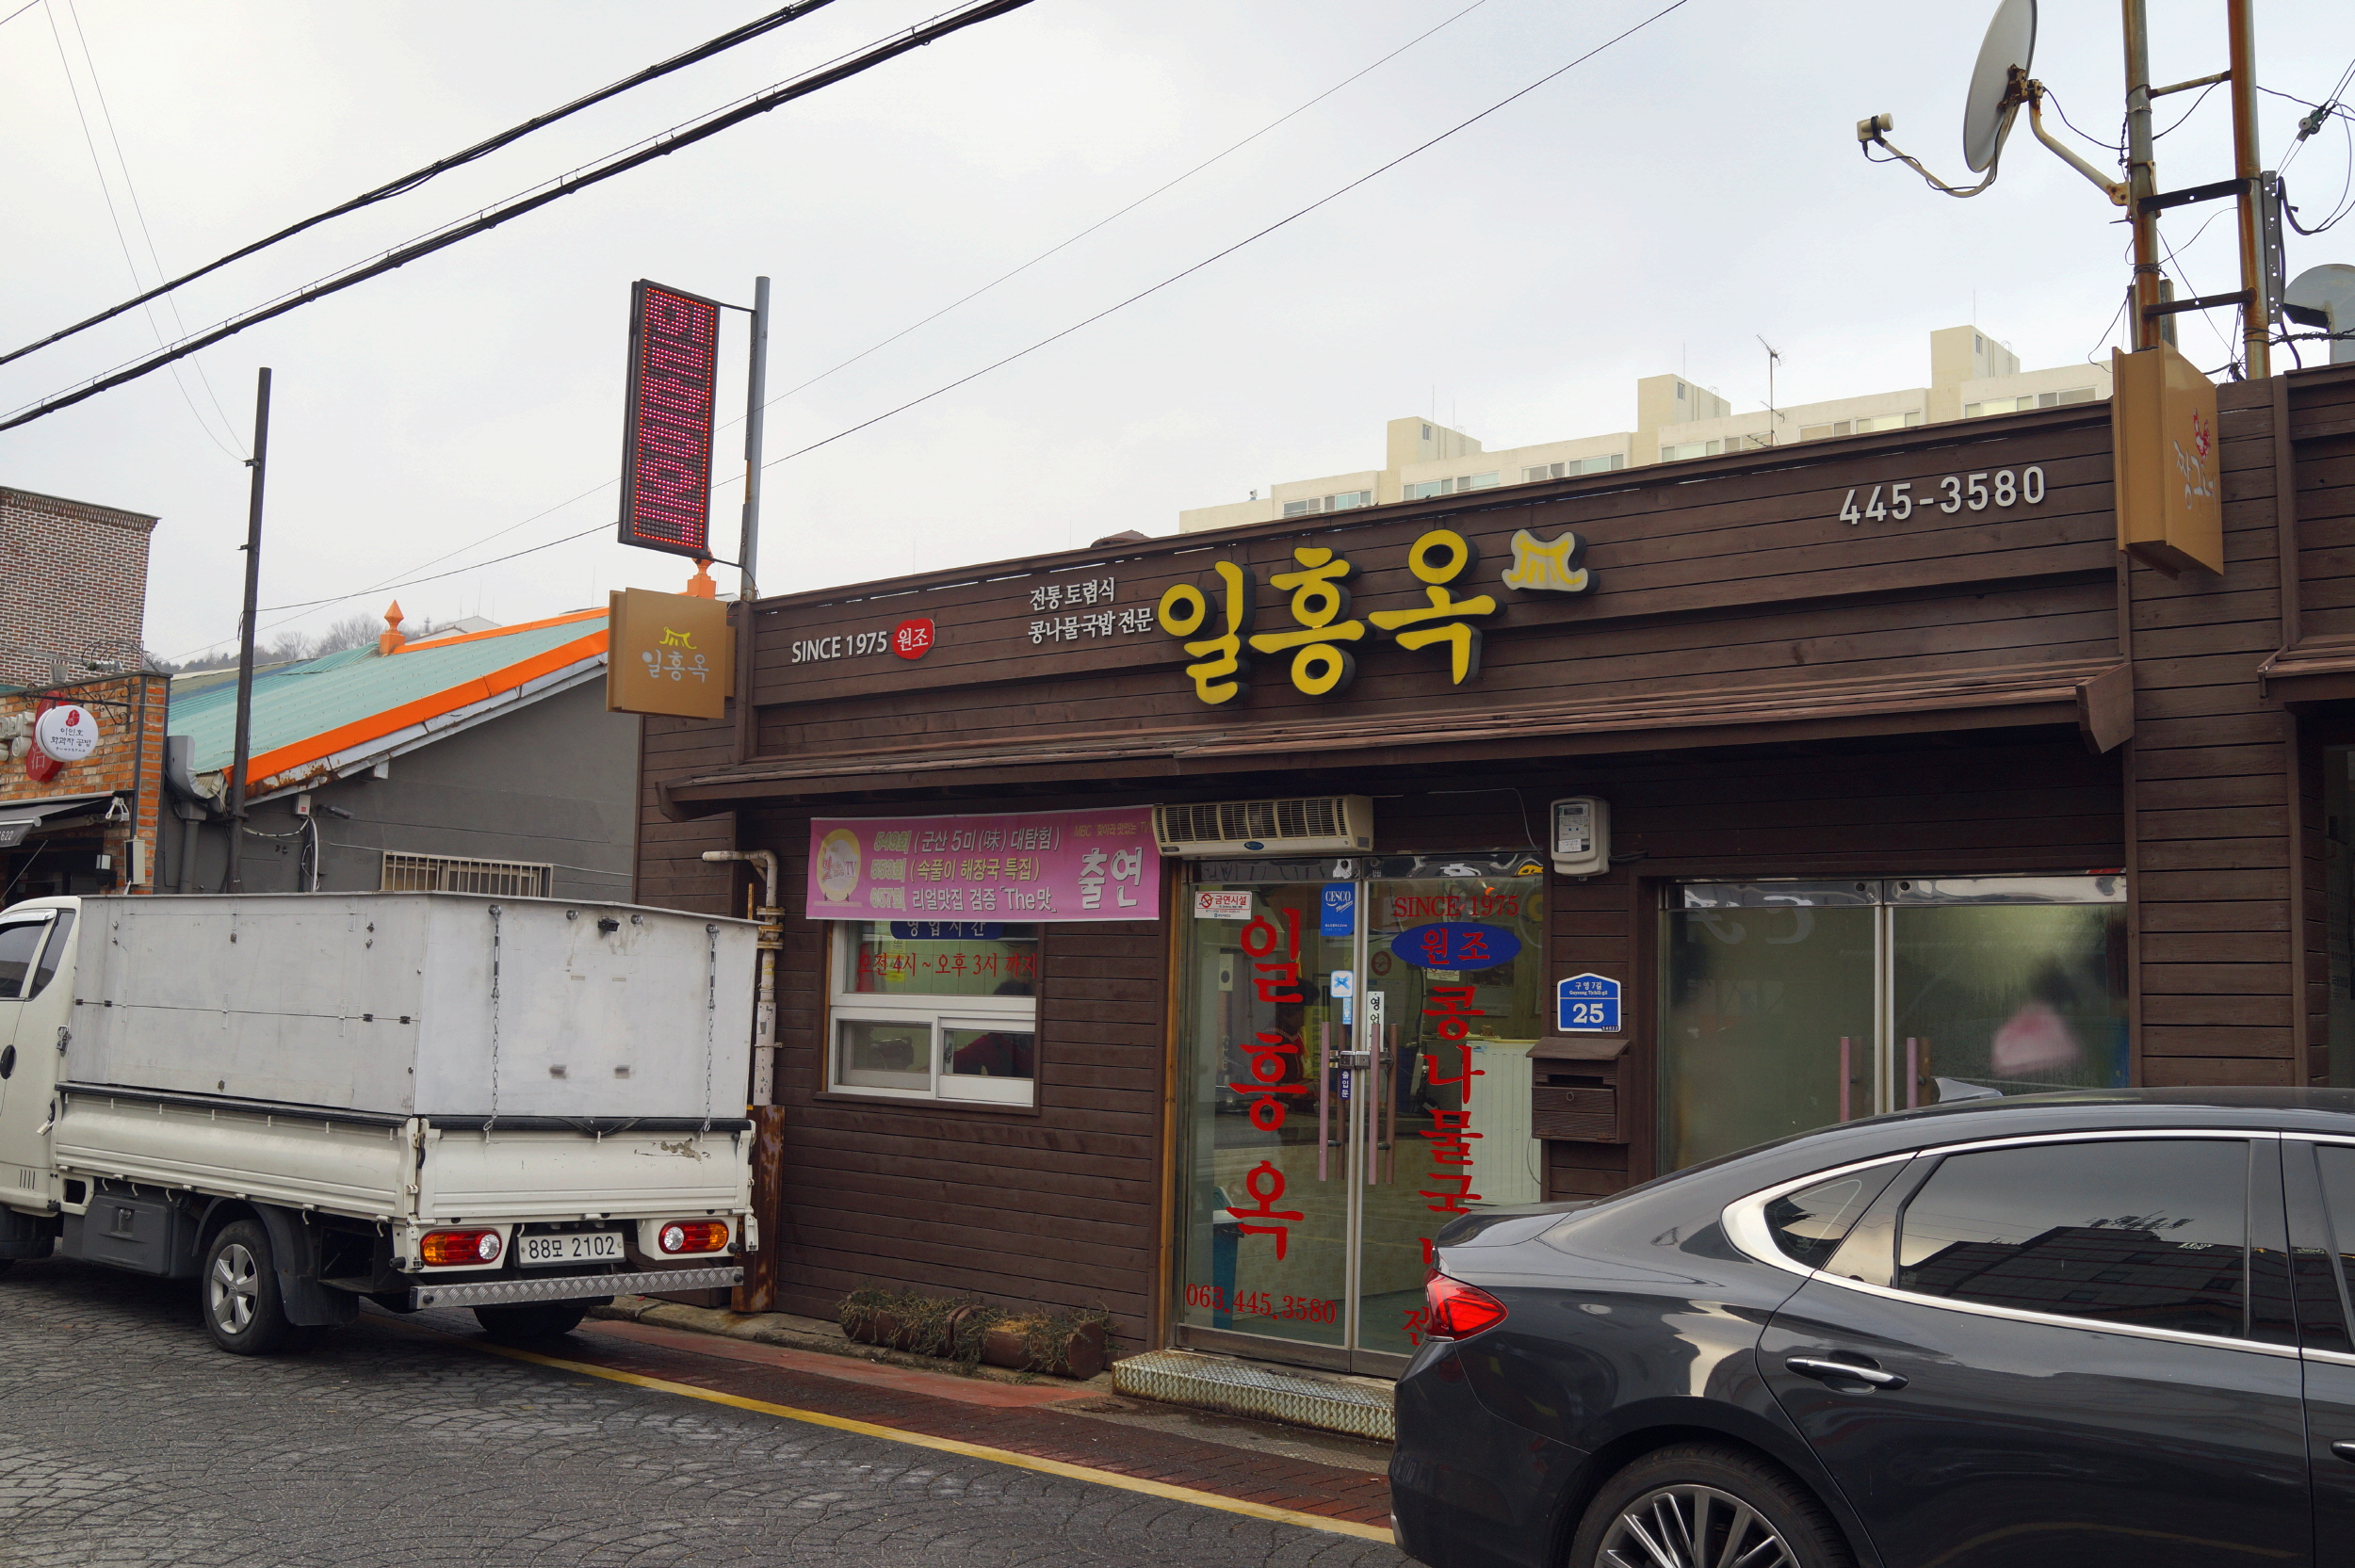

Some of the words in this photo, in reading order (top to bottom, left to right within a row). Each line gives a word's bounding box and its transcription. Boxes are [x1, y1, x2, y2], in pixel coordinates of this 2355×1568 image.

[1839, 466, 2045, 525] 445-3580
[1030, 584, 1063, 611] 전통
[1065, 576, 1116, 606] 토렴식
[1028, 613, 1115, 645] 콩나물국밥
[1118, 607, 1154, 635] 전문
[1158, 528, 1498, 705] 일흥옥
[791, 635, 841, 663] SINCE
[846, 630, 888, 656] 1975
[897, 625, 929, 653] 원조
[642, 648, 710, 684] 일흥옥
[50, 736, 74, 746] 화과자
[76, 738, 92, 748] 공방
[60, 727, 84, 737] 이인호
[0, 830, 14, 842] 622
[874, 831, 912, 854] 549회
[1074, 825, 1093, 837] MBC
[870, 858, 907, 883] 553회
[960, 857, 1000, 882] 해장국
[1079, 847, 1143, 910] 출연
[869, 887, 906, 912] 657회
[912, 887, 964, 912] 리얼맛집
[969, 888, 997, 912] 검증
[1215, 895, 1247, 906] 금연시설
[1325, 890, 1352, 902] CESCO
[1394, 897, 1460, 918] SINCE
[1470, 895, 1519, 918] 1975
[857, 951, 887, 977] 오전
[892, 952, 917, 978] 4시
[934, 953, 967, 978] 오후
[972, 952, 998, 978] 3시
[1003, 952, 1037, 978] 까지
[1572, 1002, 1605, 1024] 25
[1226, 907, 1308, 1262] 일흥옥
[1341, 1070, 1350, 1098] 출입문
[528, 1237, 563, 1259] 88모
[571, 1235, 615, 1257] 2102
[1185, 1283, 1337, 1325] 063.445.3580
